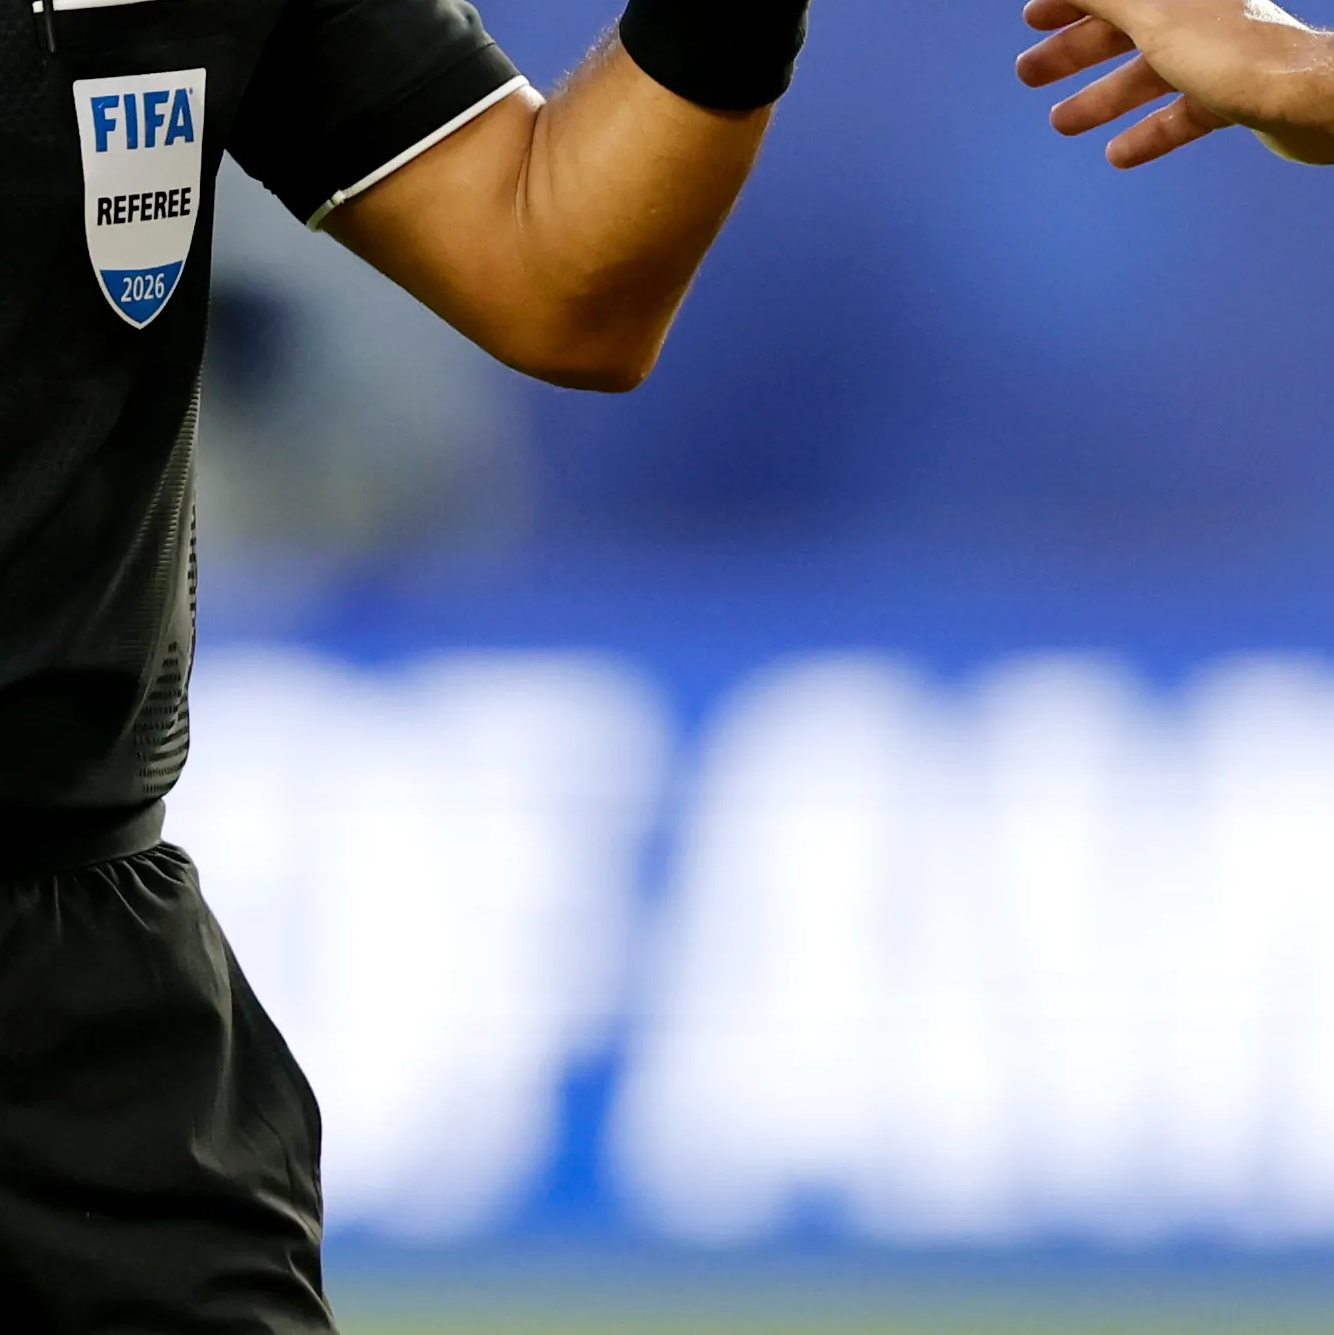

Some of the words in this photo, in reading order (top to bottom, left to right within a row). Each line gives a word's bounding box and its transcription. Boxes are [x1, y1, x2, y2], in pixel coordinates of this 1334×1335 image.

[91, 87, 195, 154] FIFA
[95, 186, 192, 227] REFEREE
[120, 272, 166, 304] 2026
